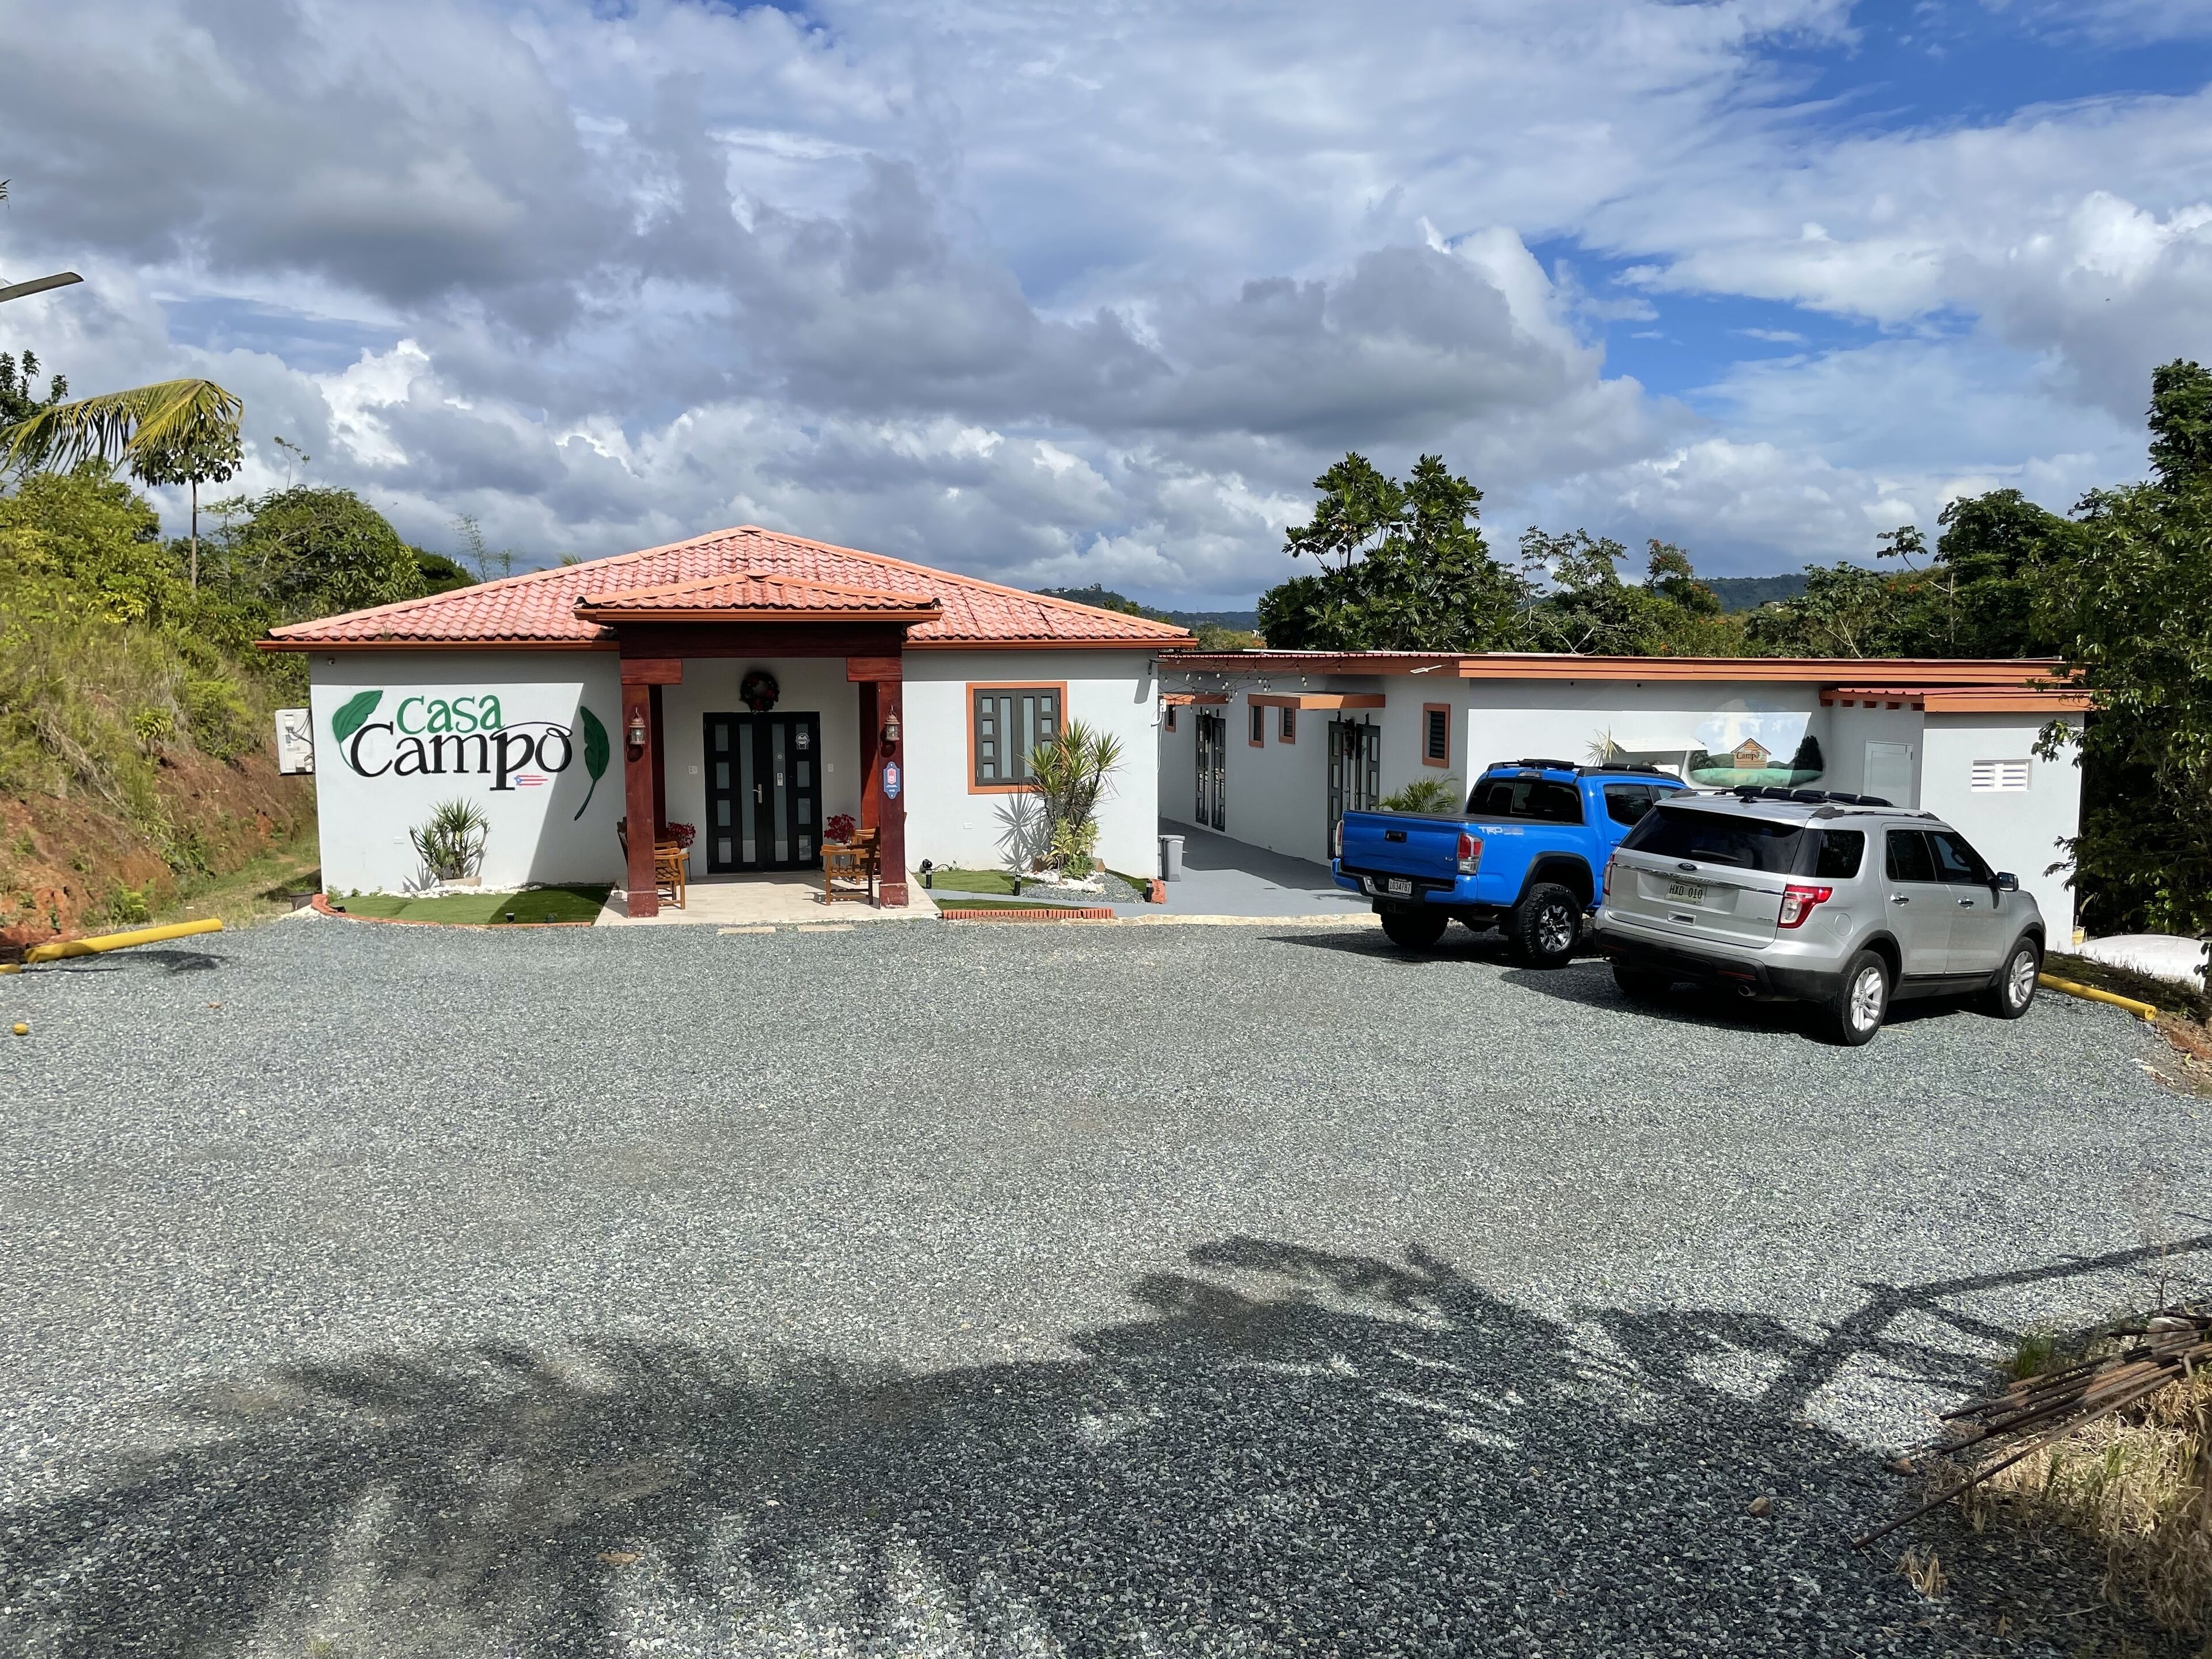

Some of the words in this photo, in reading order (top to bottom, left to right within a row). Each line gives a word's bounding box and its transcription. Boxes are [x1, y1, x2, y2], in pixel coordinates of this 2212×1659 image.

[350, 721, 573, 791] Campo
[1478, 826, 1503, 835] TRD
[1389, 881, 1411, 892] 1034787
[1669, 884, 1684, 896] HXD
[1688, 887, 1703, 899] 010
